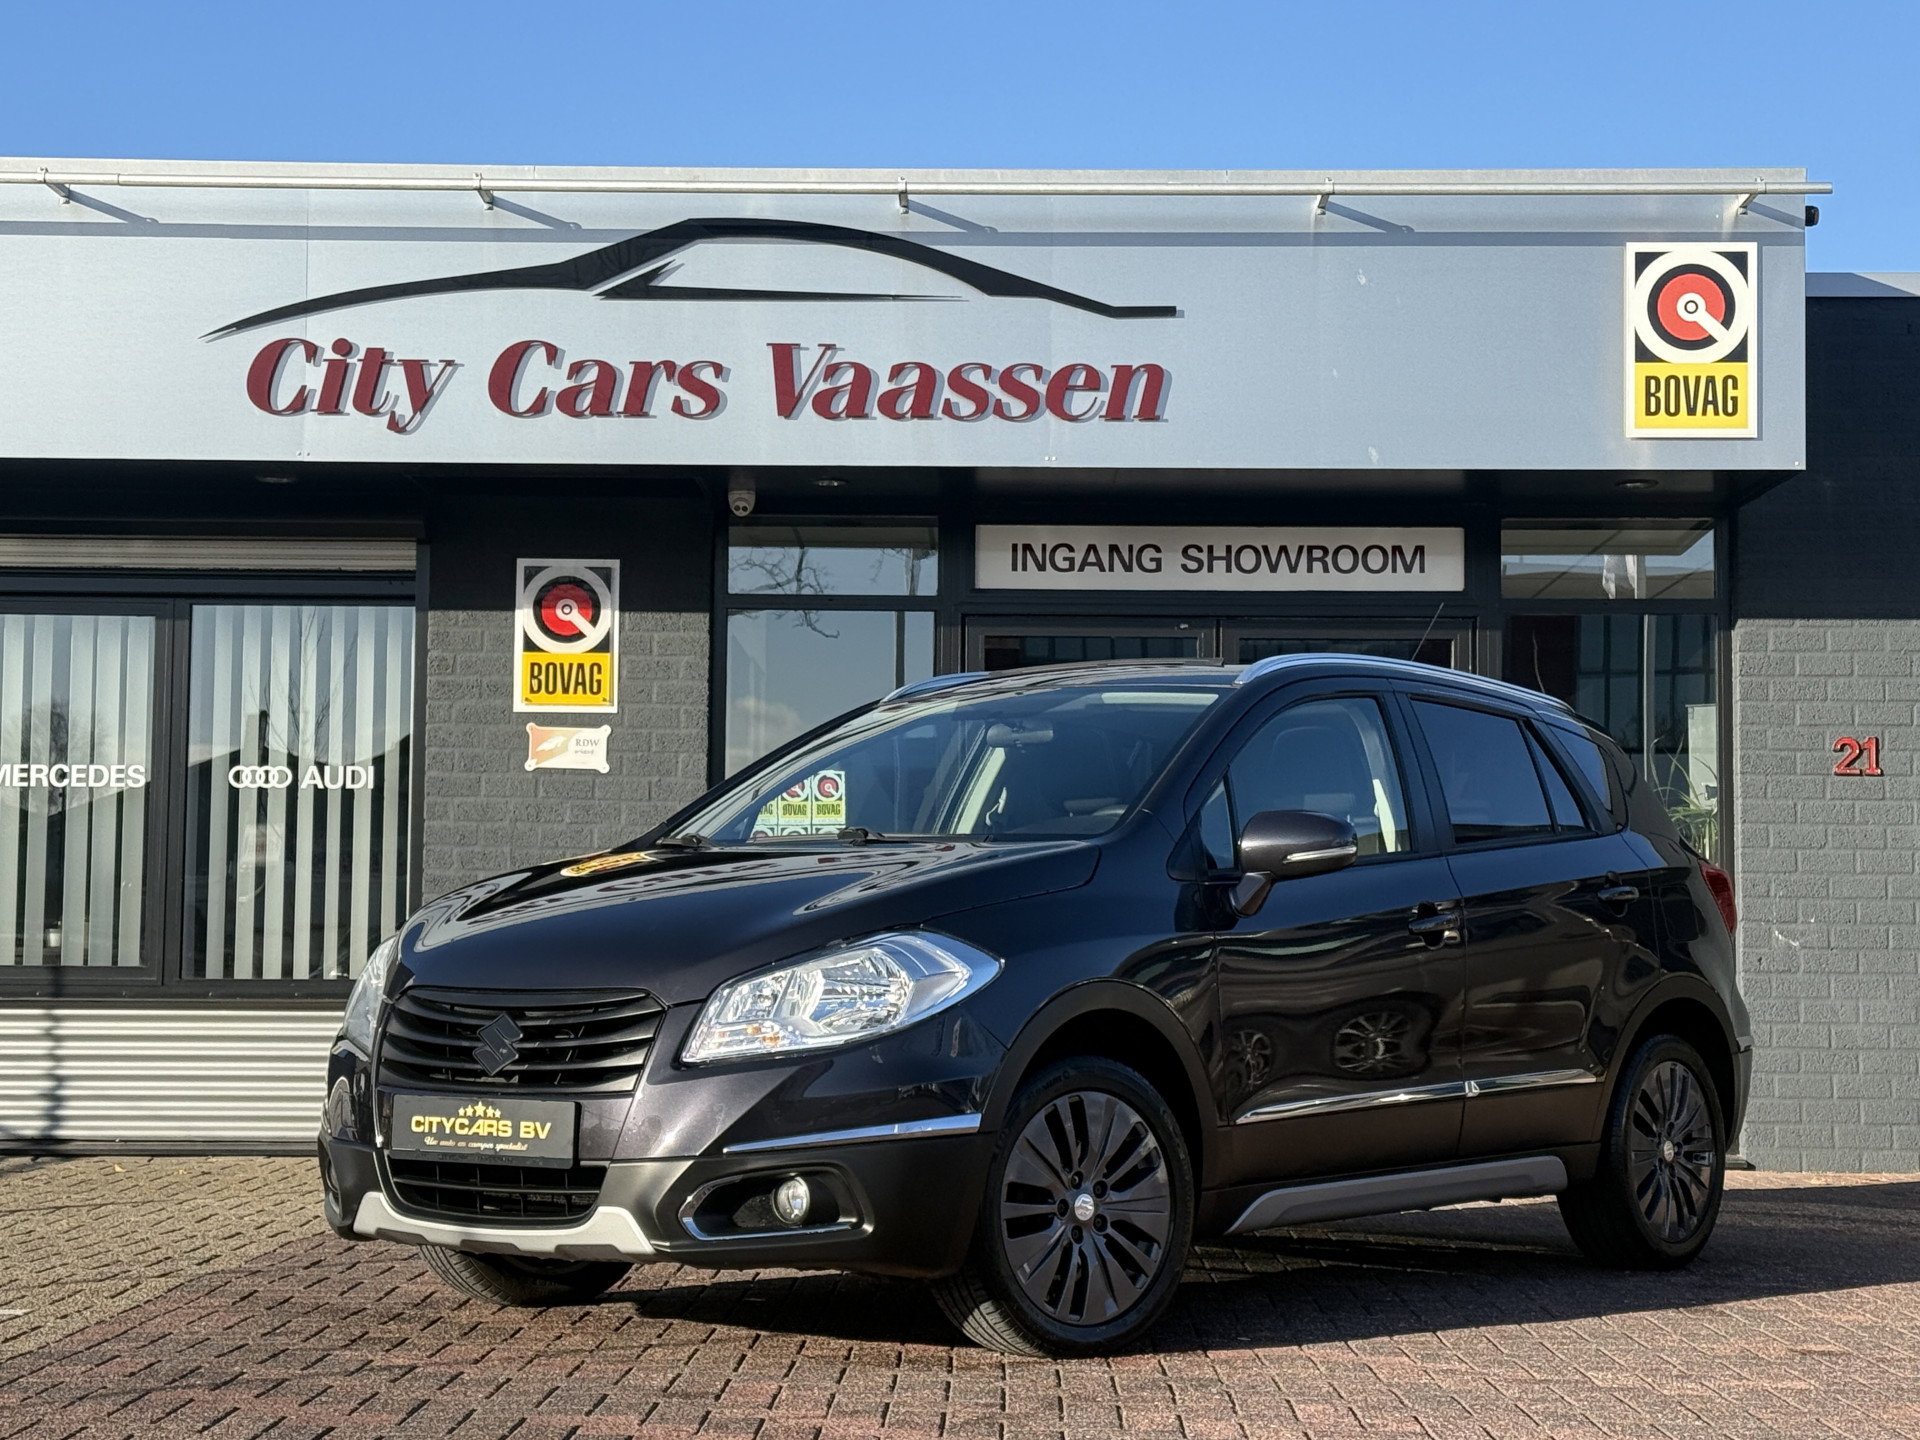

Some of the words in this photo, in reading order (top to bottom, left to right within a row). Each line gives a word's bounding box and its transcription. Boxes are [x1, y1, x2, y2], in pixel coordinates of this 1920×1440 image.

[246, 337, 460, 435] City
[487, 339, 727, 419] Cars
[766, 342, 1168, 422] Vaassen
[1644, 374, 1739, 417] BOVAG
[1010, 542, 1163, 574] INGANG
[1180, 543, 1426, 575] SHOWROOM
[529, 661, 603, 696] BOVAG
[575, 738, 600, 747] RDW
[1833, 737, 1883, 776] 21
[300, 765, 375, 790] AUDI
[782, 803, 807, 816] BOVAG
[816, 803, 841, 816] BOVAG
[411, 1116, 512, 1137] CITYCARS
[519, 1121, 552, 1140] BV
